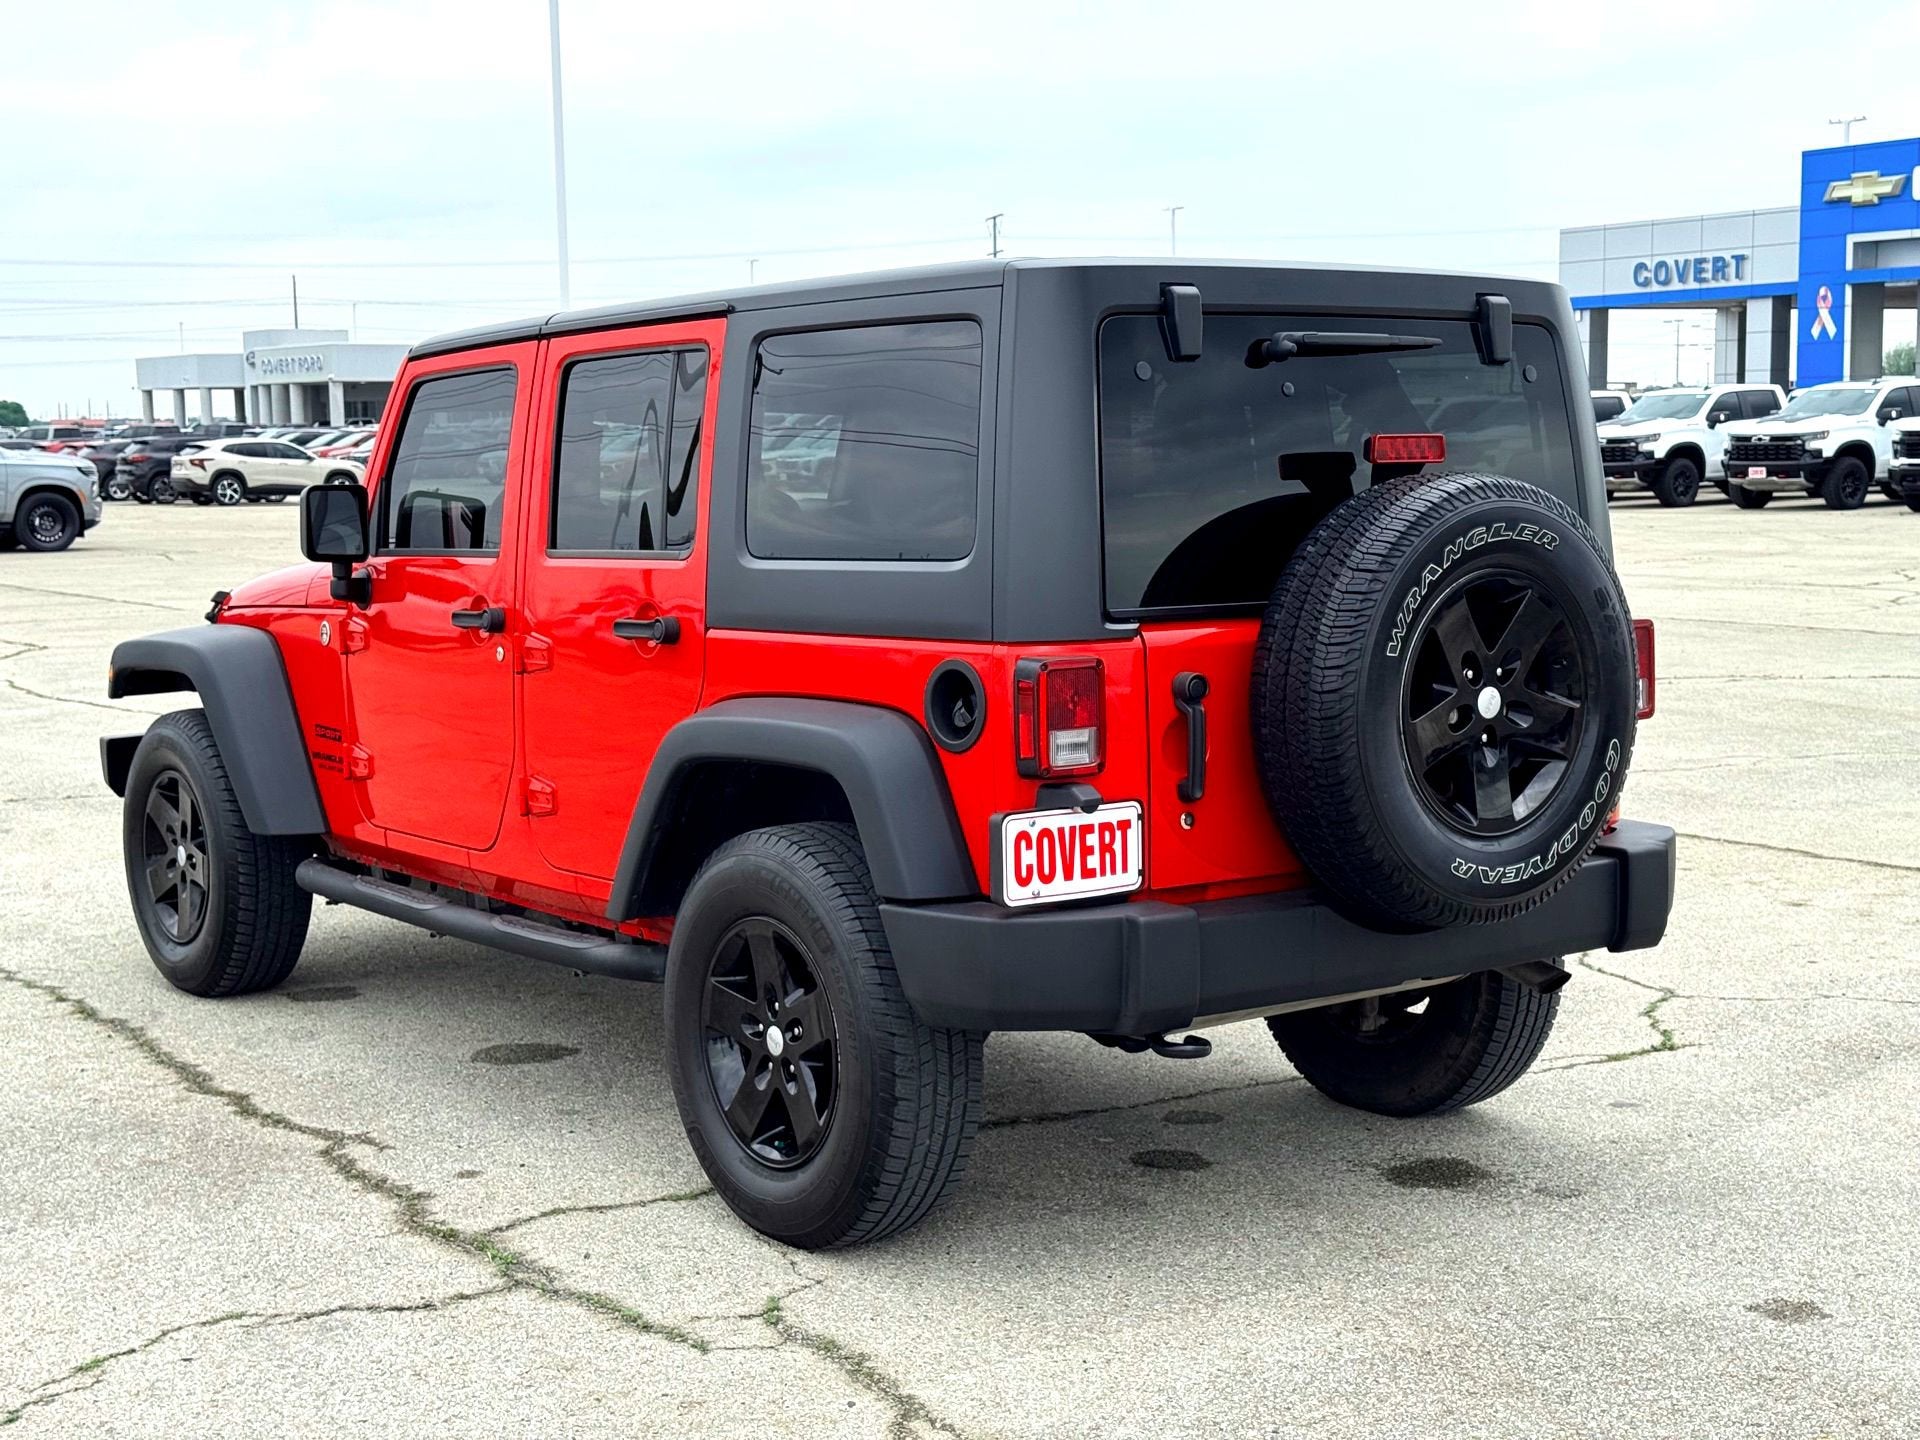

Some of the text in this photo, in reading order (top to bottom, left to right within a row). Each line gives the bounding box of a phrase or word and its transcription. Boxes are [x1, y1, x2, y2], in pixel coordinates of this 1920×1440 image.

[1633, 254, 1748, 288] COVERT
[261, 354, 323, 374] COVERT FORD
[1386, 523, 1560, 656] WRANGLER
[1450, 738, 1621, 884] GOODYEAR
[1013, 818, 1132, 888] COVERT
